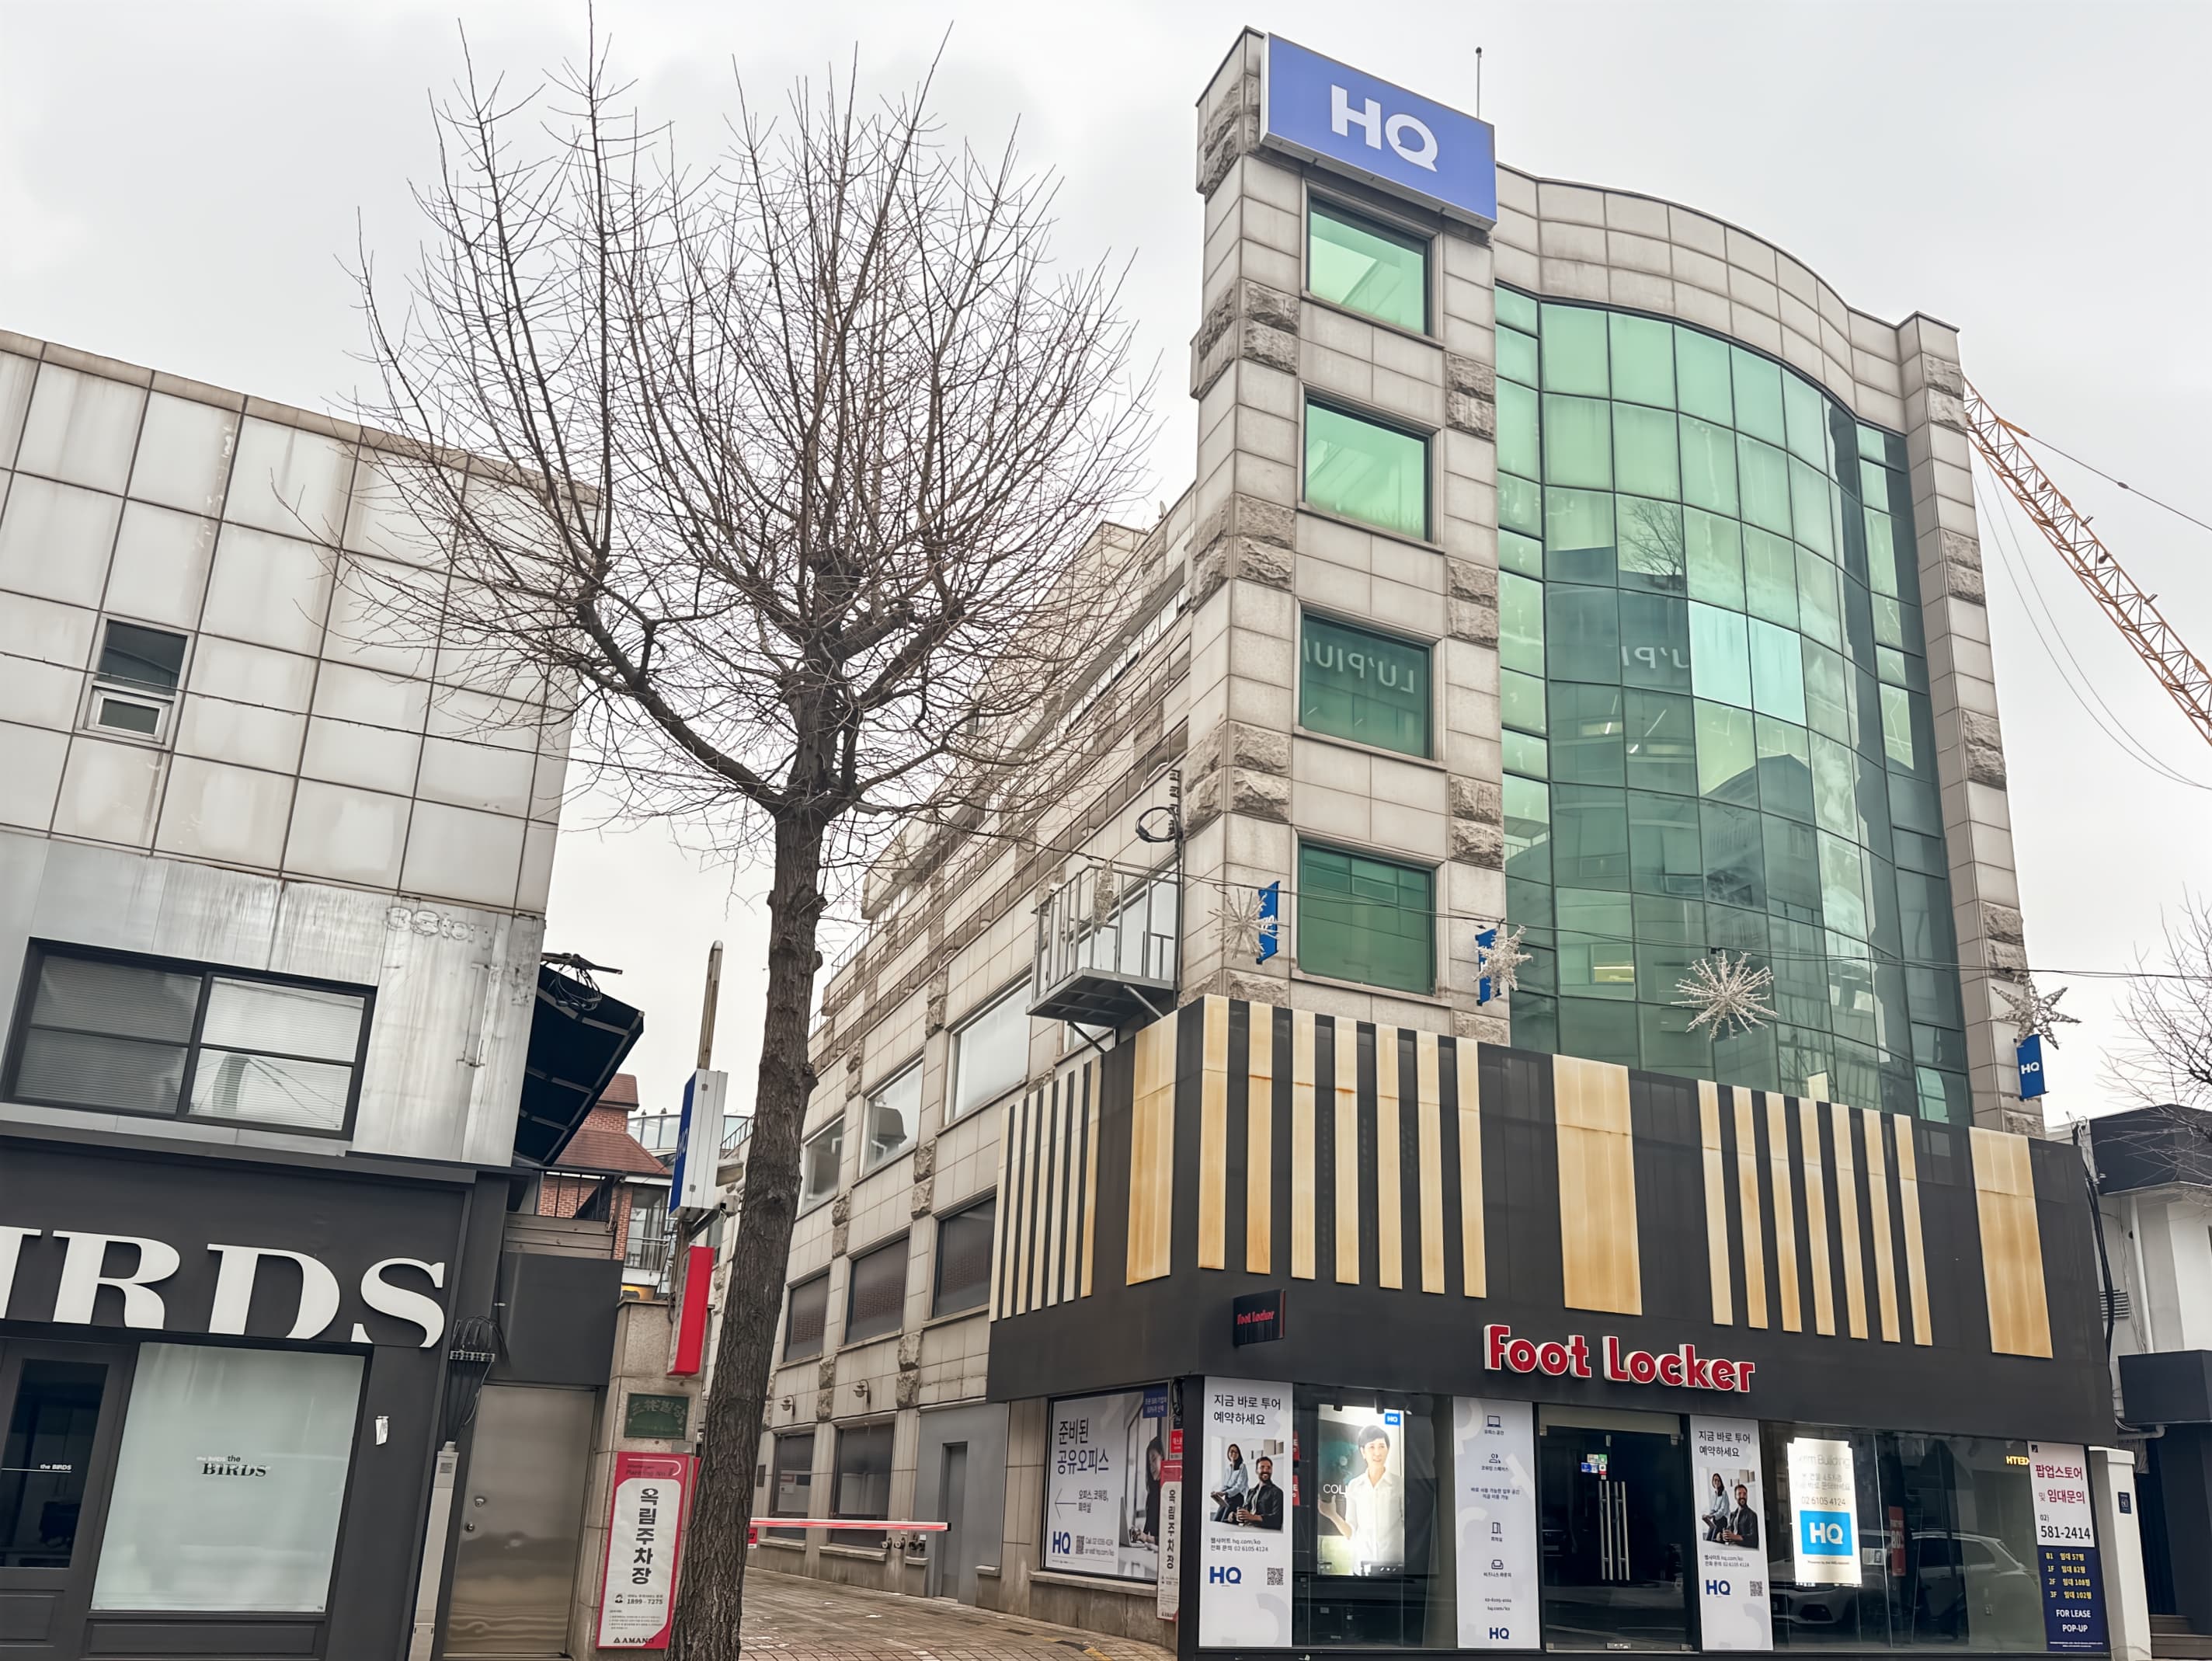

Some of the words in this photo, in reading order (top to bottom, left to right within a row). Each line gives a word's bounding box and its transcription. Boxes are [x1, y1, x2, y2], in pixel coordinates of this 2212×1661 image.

[1331, 84, 1438, 172] HQ
[2021, 1062, 2040, 1074] HQ
[1484, 1323, 1591, 1378] Foot
[1602, 1335, 1755, 1393] Locker
[1214, 1394, 1234, 1407] 지금
[1237, 1395, 1258, 1408] 바로
[1261, 1398, 1281, 1410] 투어
[1213, 1412, 1266, 1425] 예약하세요
[1059, 1417, 1089, 1445] 준비된
[1698, 1430, 1714, 1442] 지금
[1716, 1432, 1733, 1443] 바로
[1735, 1433, 1751, 1444] 투어
[1699, 1446, 1740, 1457] 예약하세요
[1057, 1447, 1109, 1475] 공유오피스
[202, 1463, 266, 1477] BIRDS
[2035, 1464, 2083, 1481] 팝업스토어
[1323, 1484, 1348, 1495] COL
[2047, 1489, 2085, 1504] 임대문의
[631, 1488, 659, 1585] 옥림주차장
[1167, 1489, 1176, 1569] 옥림주차장
[1809, 1522, 1843, 1544] HQ
[2040, 1525, 2091, 1540] 581-2414
[1052, 1530, 1071, 1554] HQ
[1209, 1566, 1242, 1584] HQ
[1706, 1579, 1731, 1596] HQ
[1489, 1628, 1510, 1639] HQ
